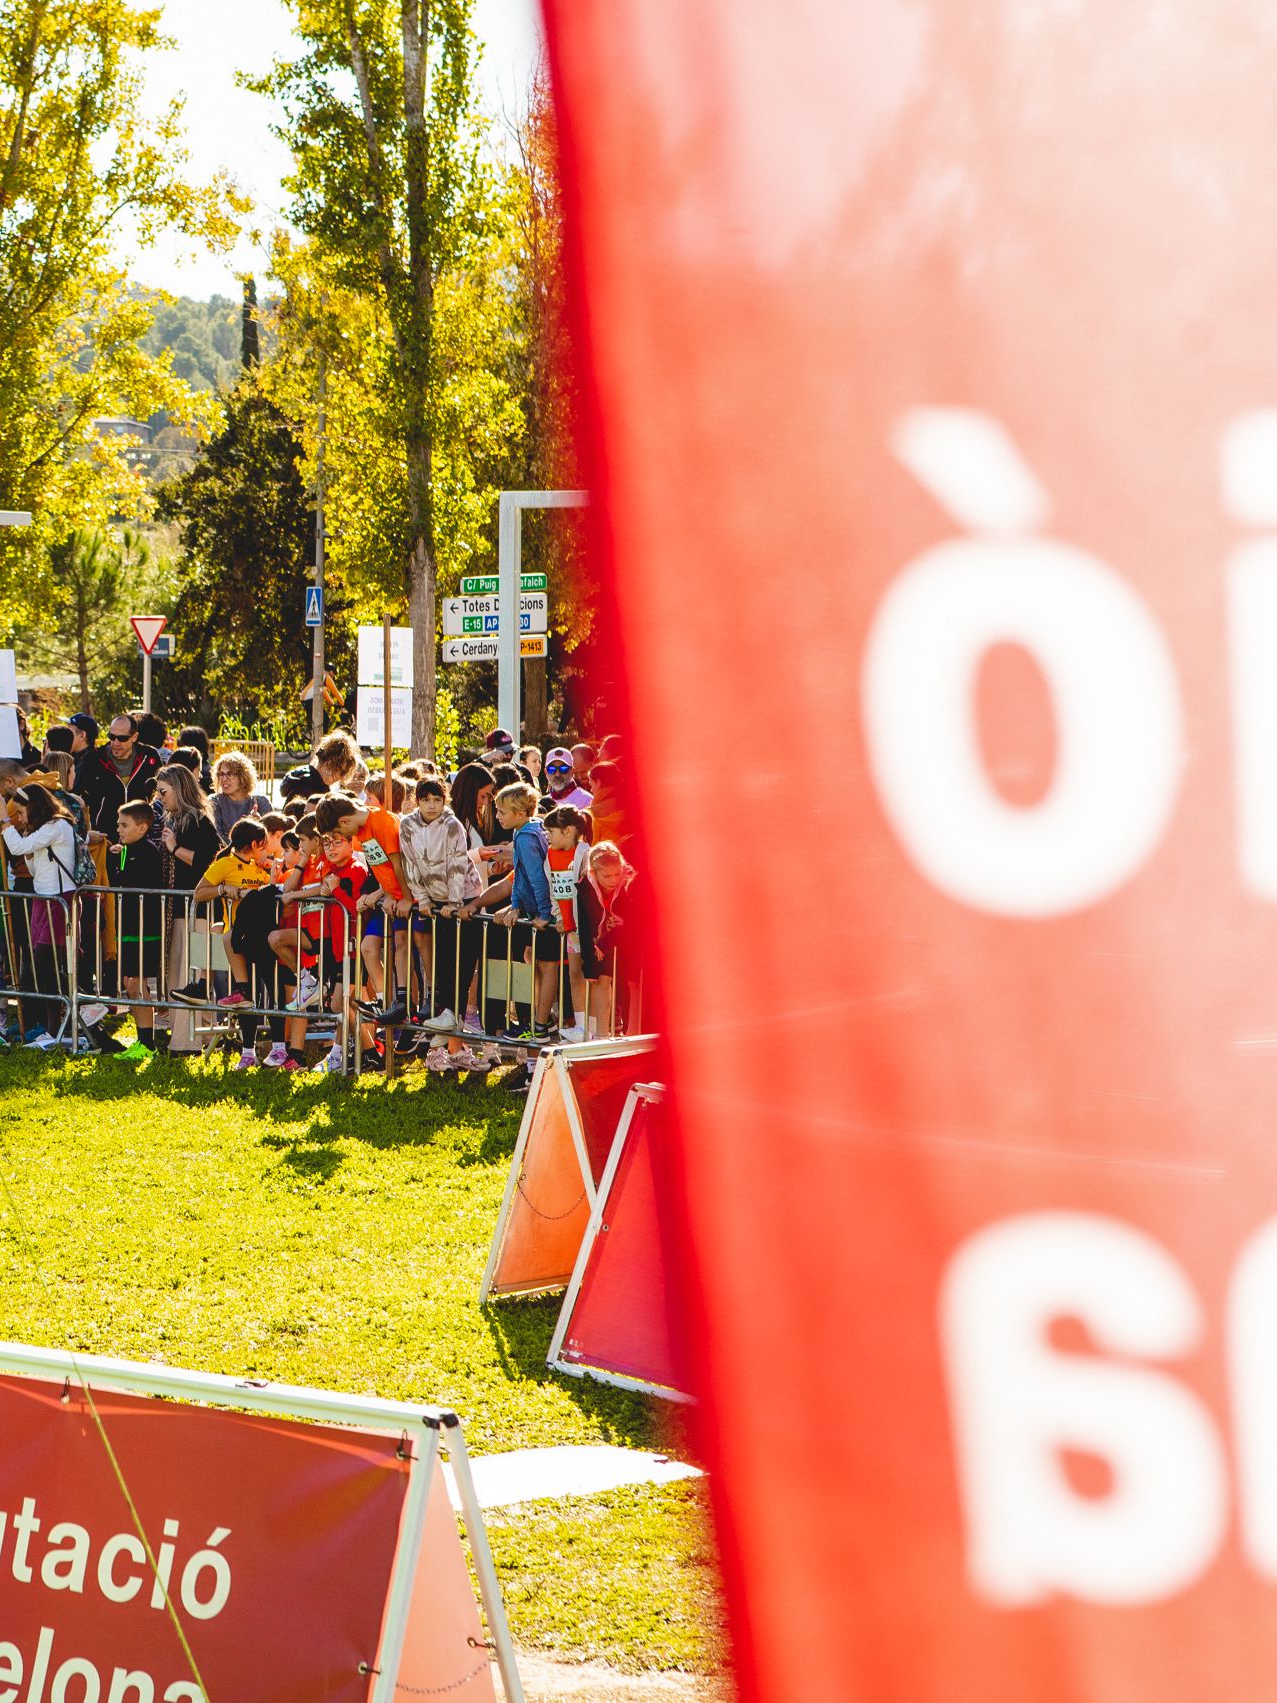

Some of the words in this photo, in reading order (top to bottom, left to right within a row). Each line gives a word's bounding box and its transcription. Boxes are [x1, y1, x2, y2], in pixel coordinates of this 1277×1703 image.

[467, 580, 476, 590] C/
[479, 578, 497, 591] Puig
[462, 599, 491, 613] Totes
[464, 618, 481, 630] E-15
[462, 641, 499, 656] Cerdany
[520, 641, 542, 652] P-1413
